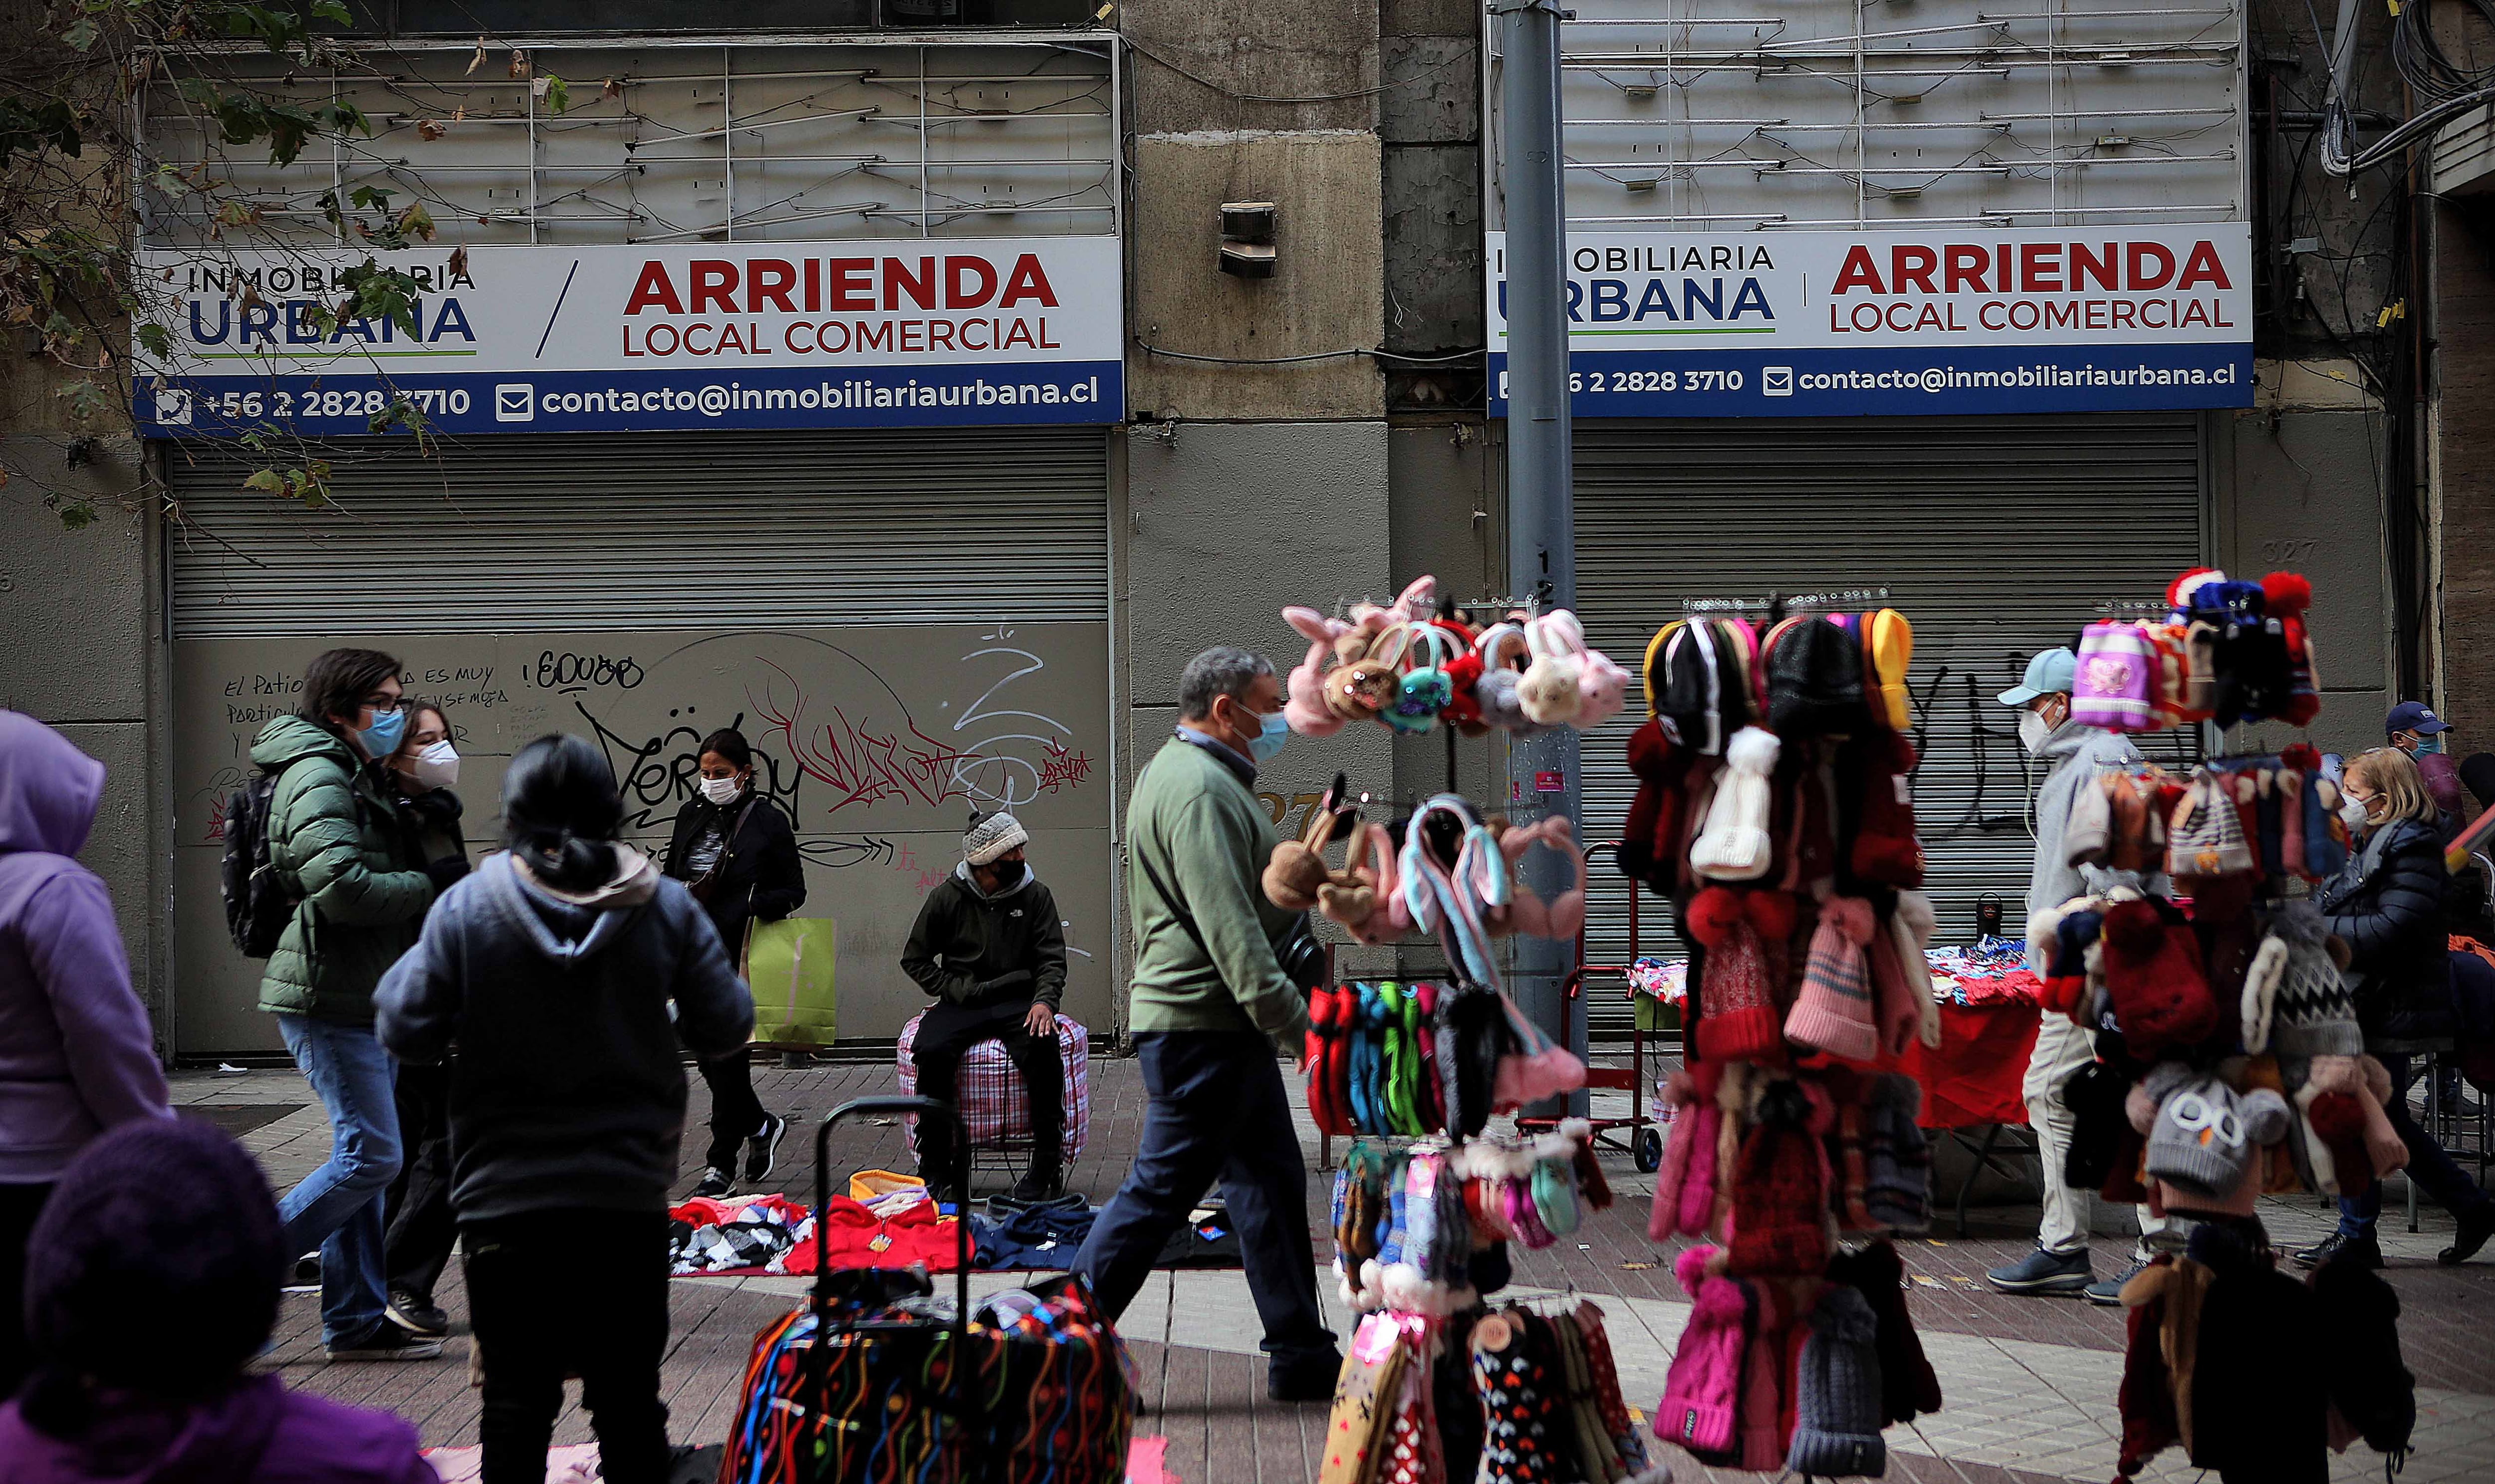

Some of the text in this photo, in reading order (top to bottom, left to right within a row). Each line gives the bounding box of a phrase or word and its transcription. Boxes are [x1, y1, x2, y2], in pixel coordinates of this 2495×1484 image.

[1497, 245, 1774, 273] IOBILIARIA
[1830, 241, 2234, 294] ARRIENDA
[623, 253, 1059, 315] ARRIENDA
[1497, 277, 1775, 322] RBANA
[1830, 298, 2234, 333] LOCAL COMERCIAL
[623, 317, 1061, 357] LOCAL COMERCIAL
[541, 375, 1098, 417] contacto@inmobiliariaurbana.cl
[1589, 372, 1605, 392] 2
[1611, 371, 1677, 392] 2828
[1684, 370, 1744, 391] 3710
[1798, 363, 2236, 393] contacto@inmobiliariaurbana.cl
[204, 391, 263, 417] +56
[273, 392, 292, 417] 2
[301, 391, 385, 416] 2828
